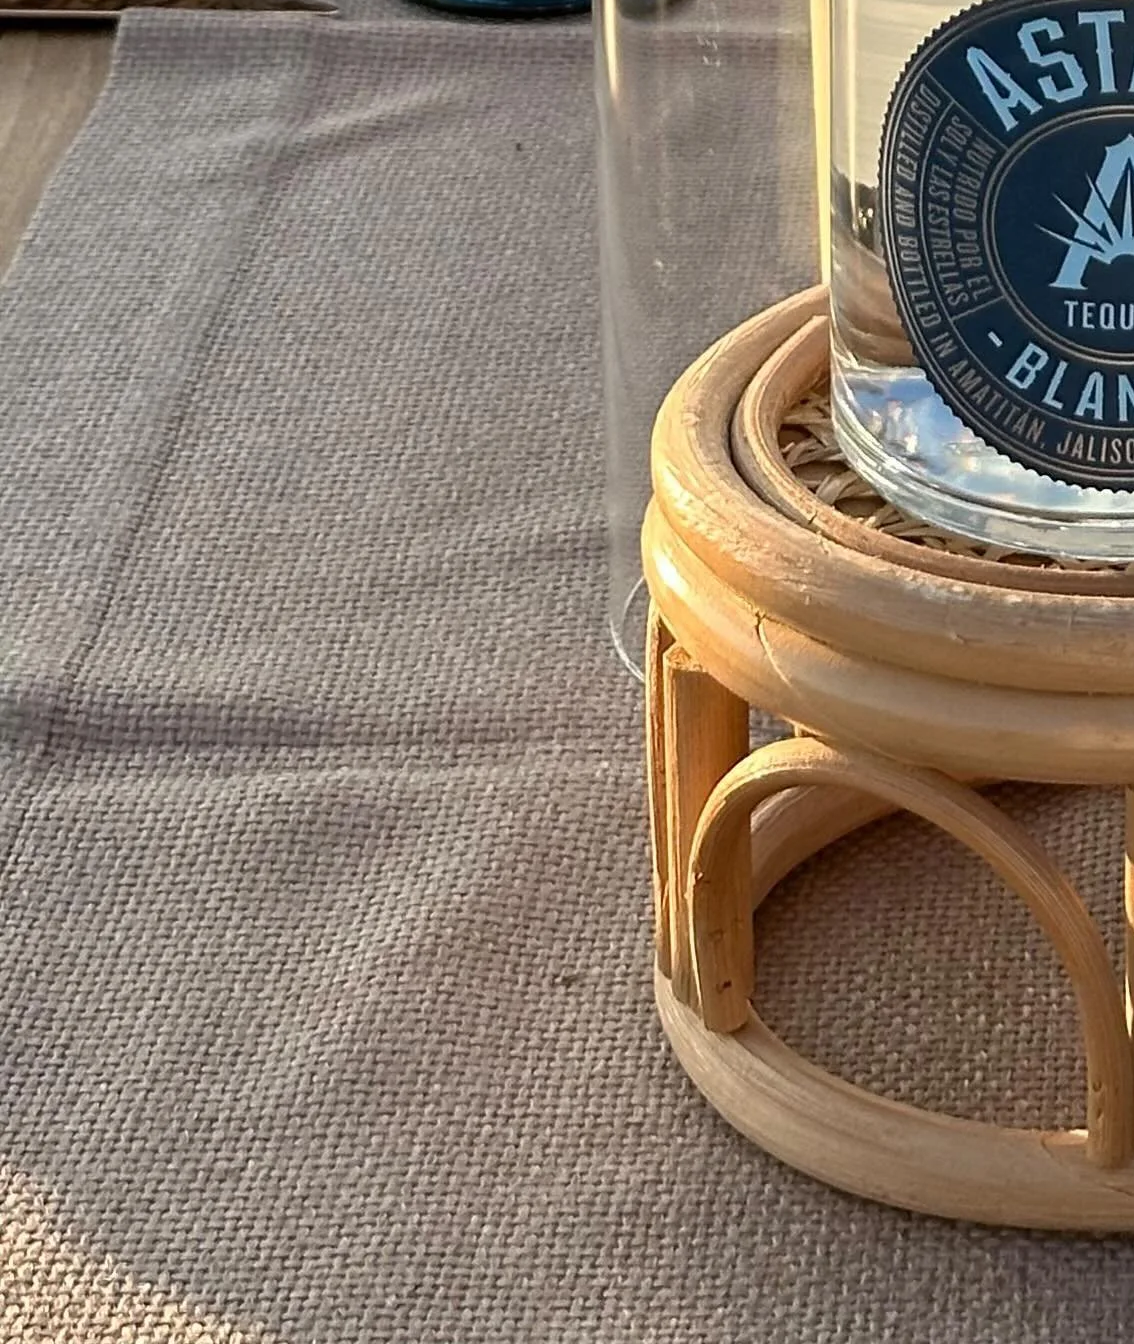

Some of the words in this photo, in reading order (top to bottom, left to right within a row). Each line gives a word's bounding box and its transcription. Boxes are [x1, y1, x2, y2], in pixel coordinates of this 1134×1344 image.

[896, 83, 942, 182] DISTILLED
[940, 115, 973, 151] SOL
[936, 148, 959, 167] Y
[928, 164, 954, 202] LAS
[952, 136, 997, 222] NUTRIDO
[894, 182, 916, 229] AND
[928, 202, 970, 307] ESTRELLAS
[954, 228, 983, 269] POR
[898, 235, 942, 328] BOTTLED
[967, 274, 994, 301] EL
[929, 331, 958, 359] IN
